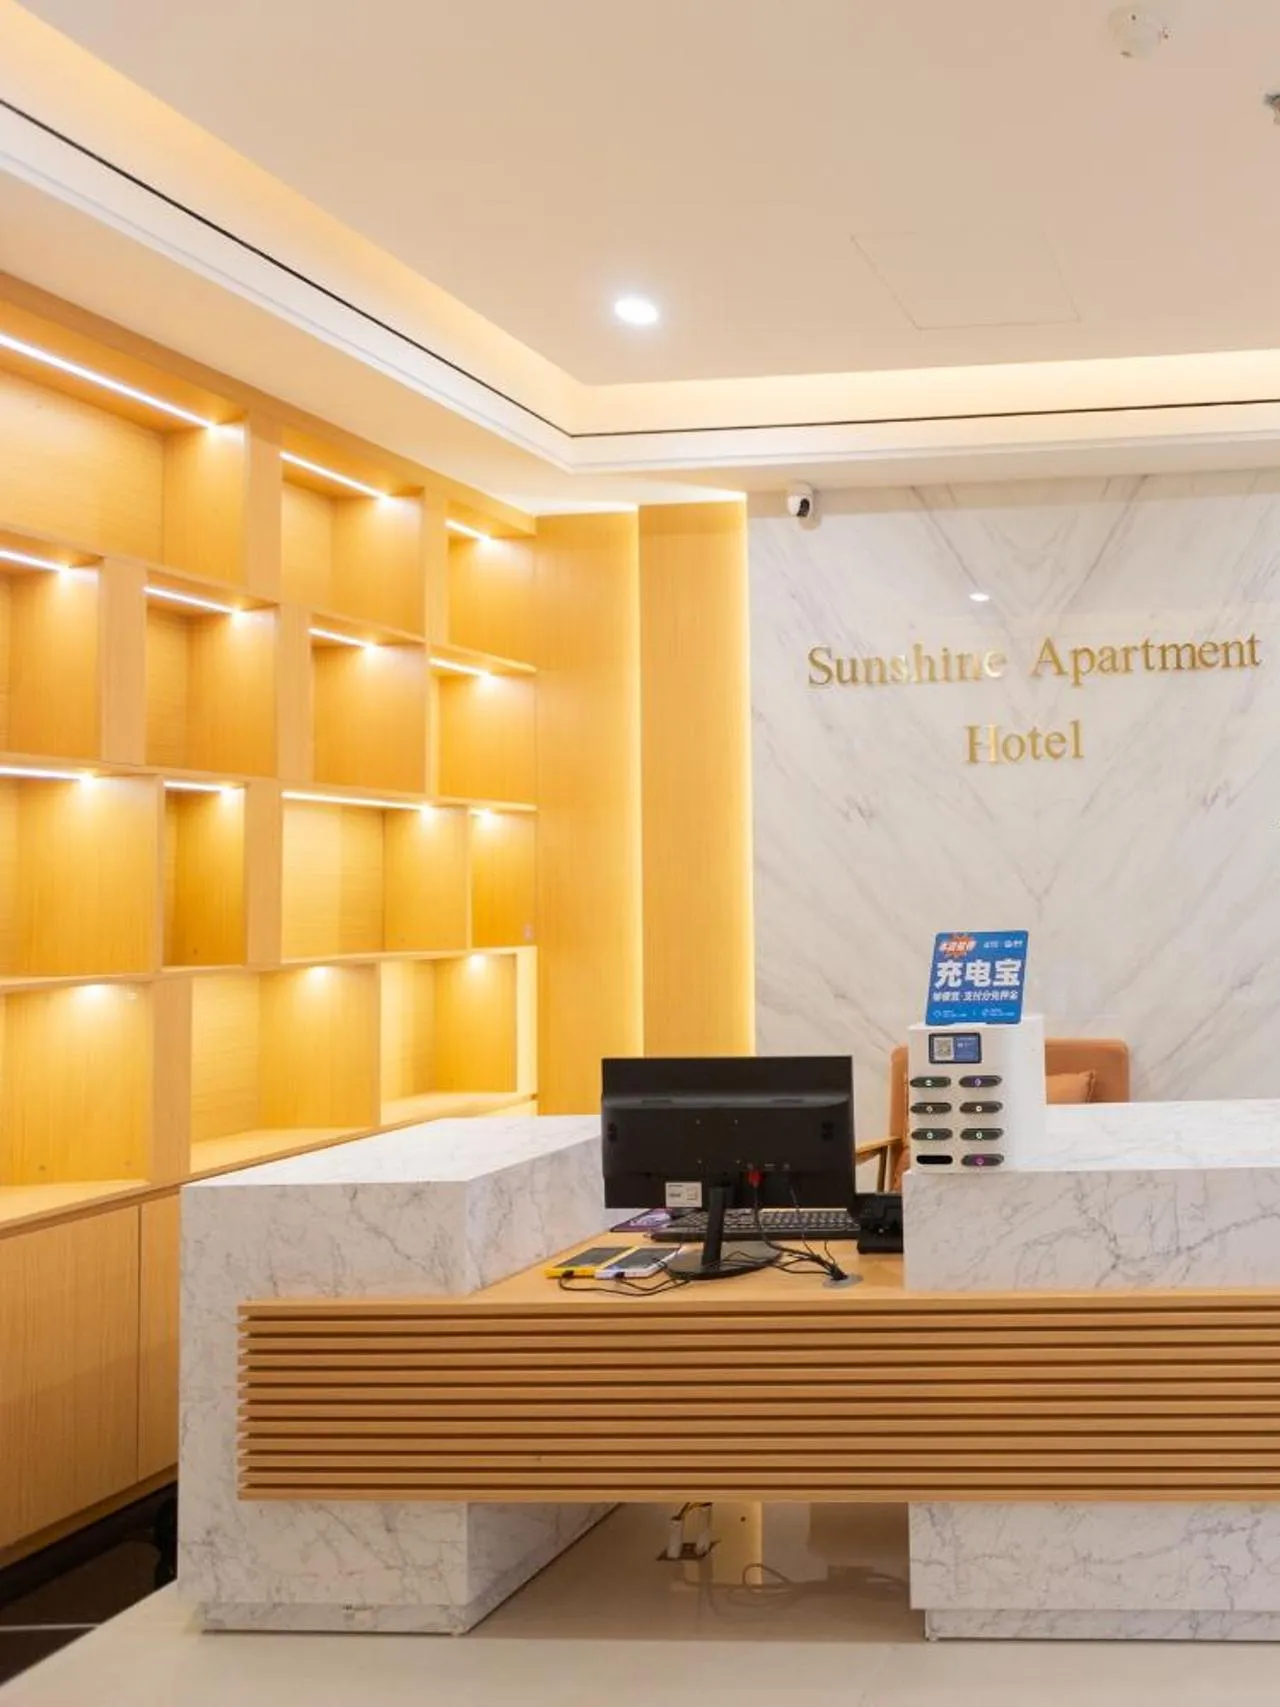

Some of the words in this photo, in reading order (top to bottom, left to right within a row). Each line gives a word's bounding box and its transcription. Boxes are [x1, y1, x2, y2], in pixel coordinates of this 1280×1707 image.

[808, 643, 1007, 687] Sunshine
[1030, 633, 1262, 687] Apartment
[964, 718, 1084, 764] Hotel
[934, 958, 1021, 988] 充电宝
